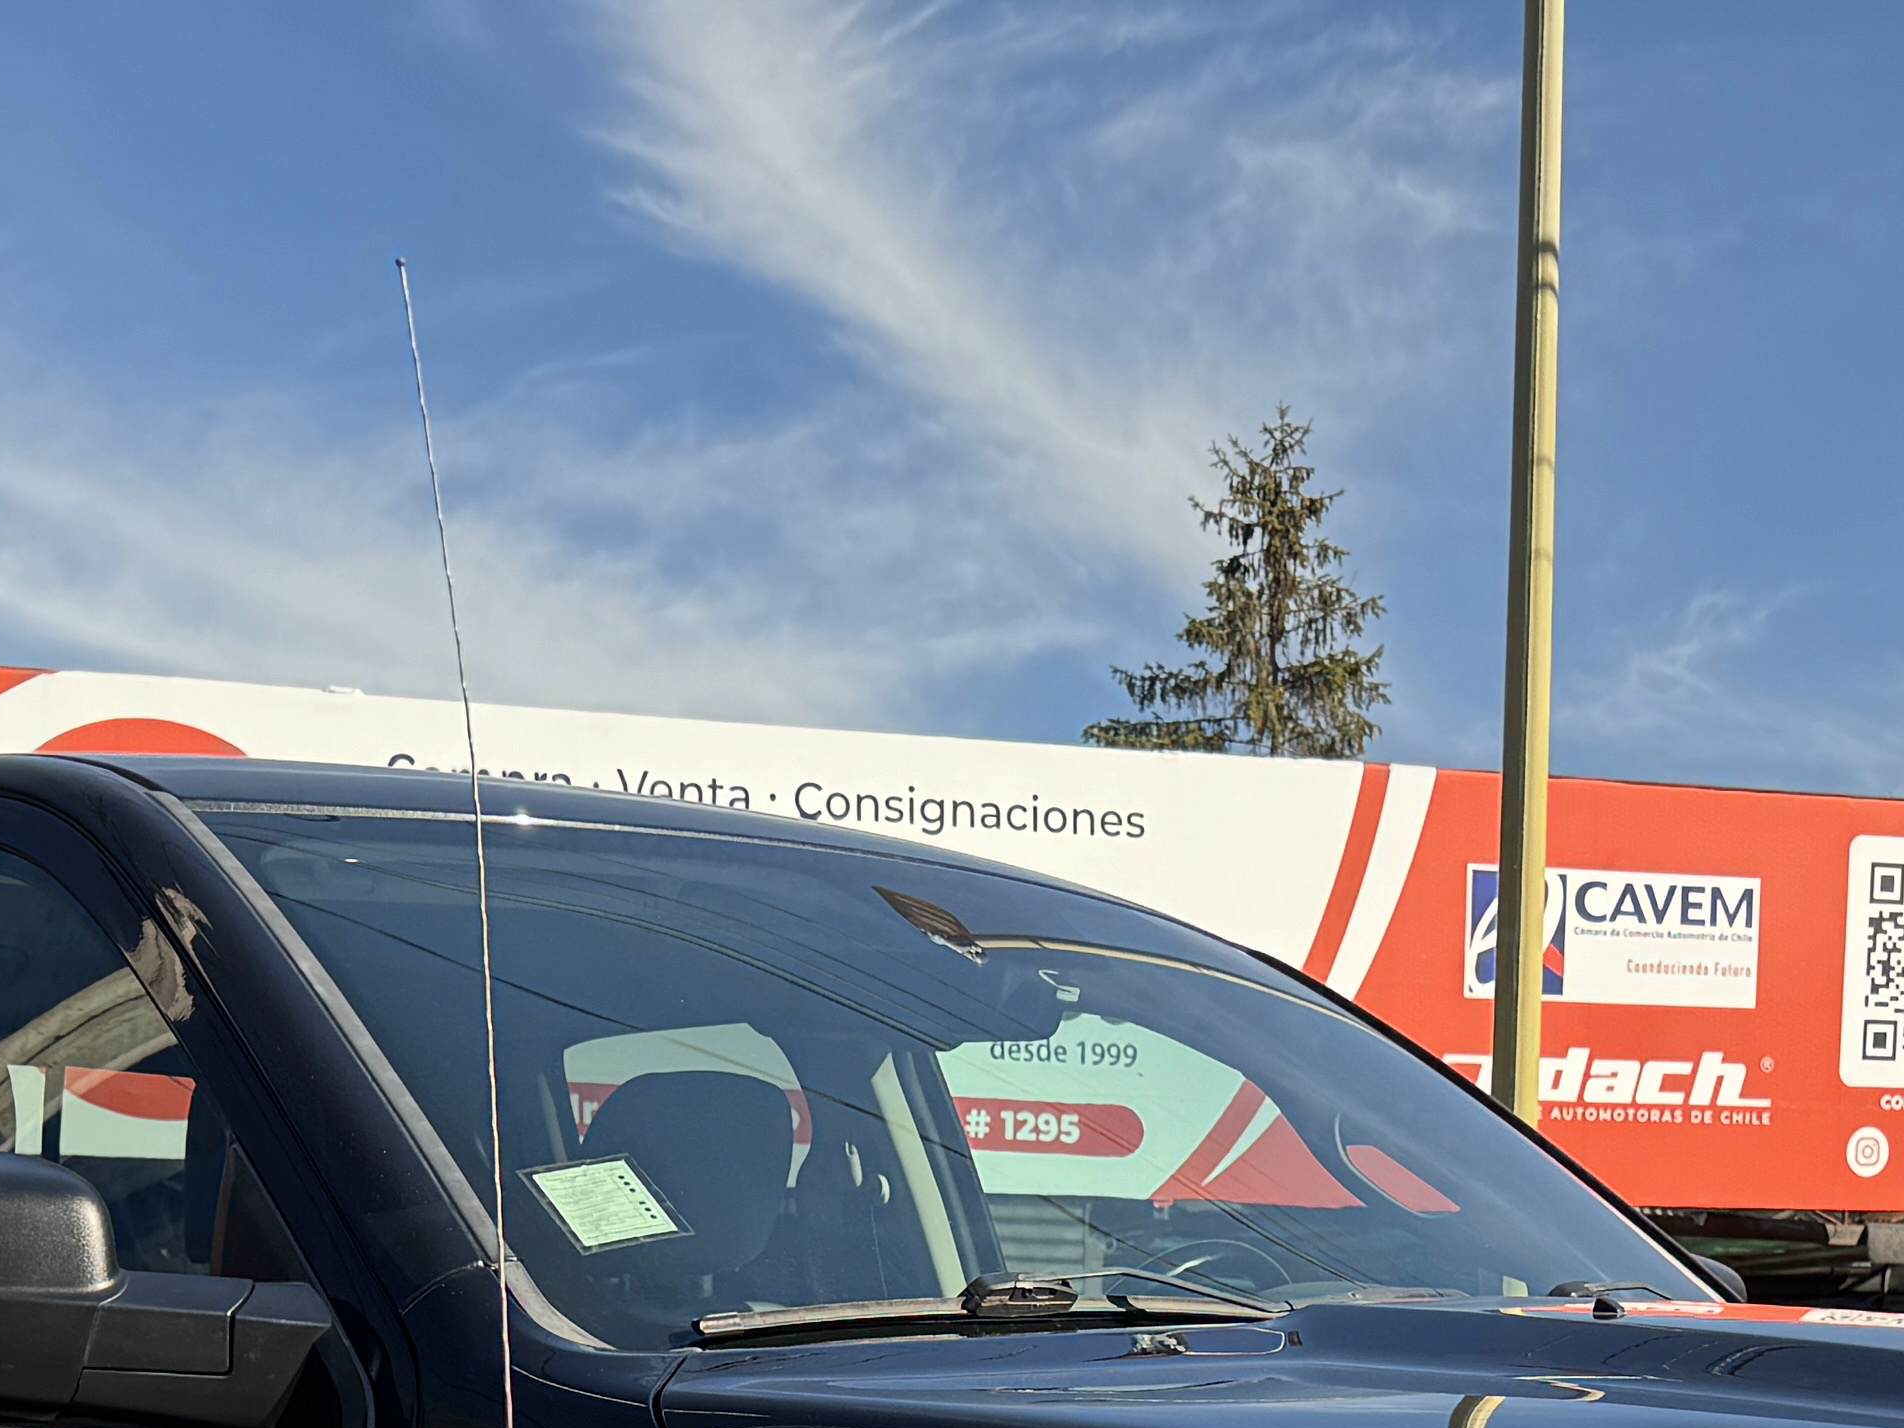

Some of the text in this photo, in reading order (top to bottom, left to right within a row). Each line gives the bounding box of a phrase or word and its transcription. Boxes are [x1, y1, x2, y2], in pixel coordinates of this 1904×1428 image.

[794, 781, 1146, 839] Consignaciones
[1574, 881, 1754, 929] CAVEM
[990, 1041, 1138, 1068] desde 1999
[1000, 1109, 1082, 1144] 1295
[1550, 1106, 1683, 1125] AUTOMOTORAS
[1690, 1109, 1713, 1126] DE
[1720, 1109, 1772, 1127] CHILE
